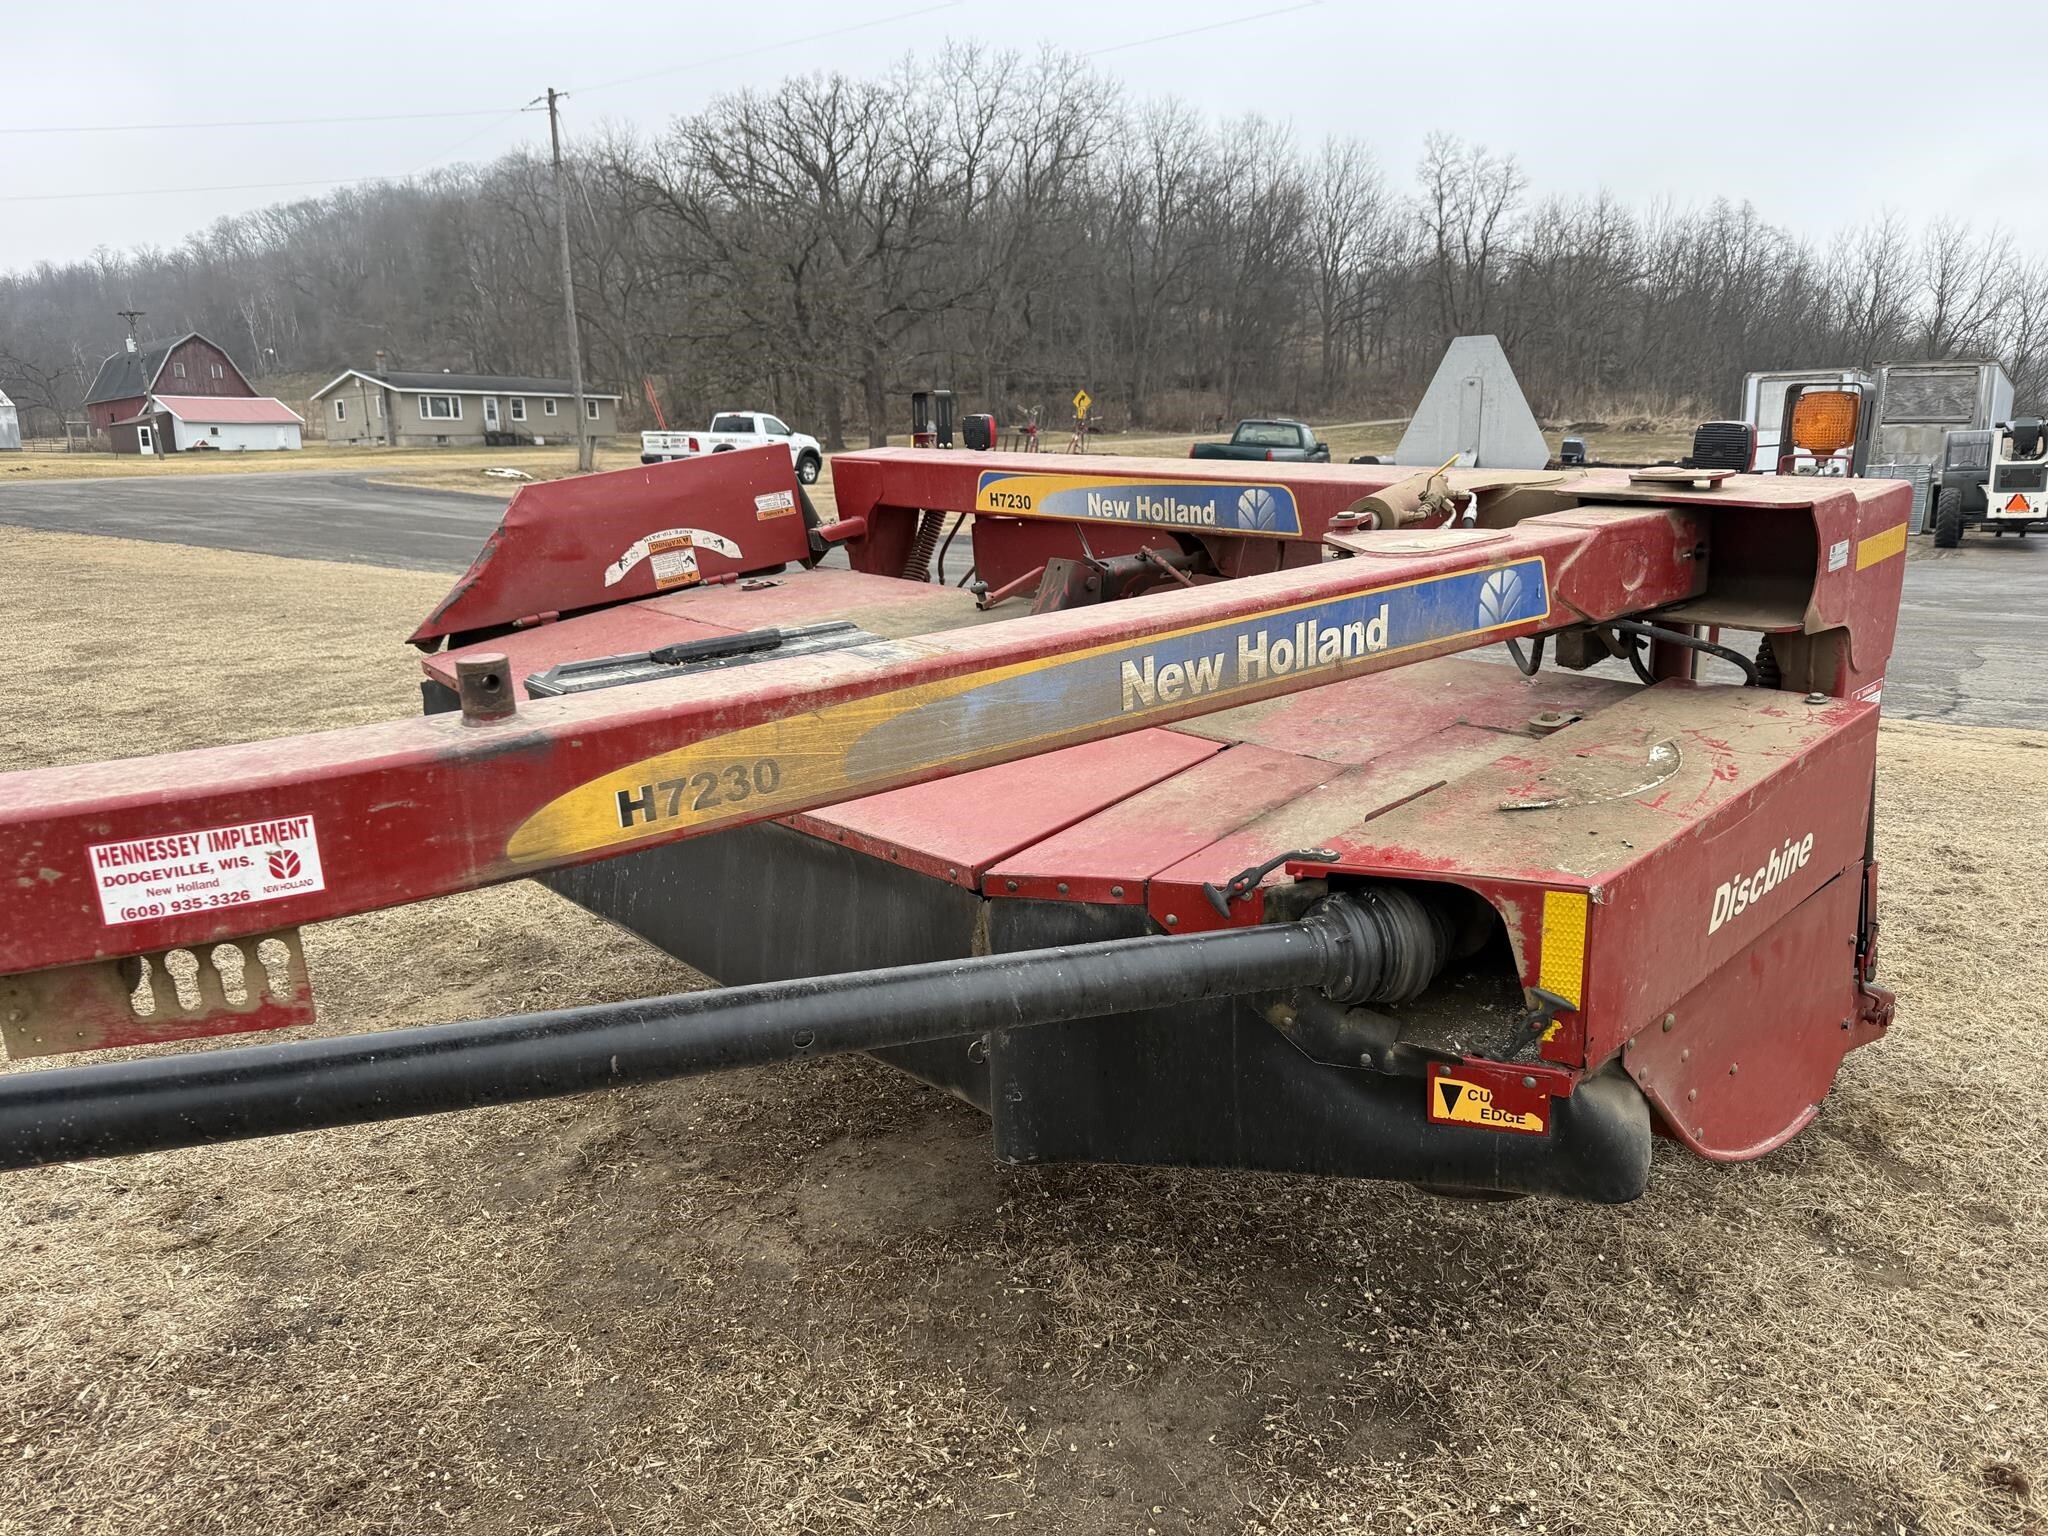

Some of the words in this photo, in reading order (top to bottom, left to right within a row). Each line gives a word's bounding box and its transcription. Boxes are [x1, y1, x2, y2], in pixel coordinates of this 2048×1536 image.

[990, 492, 1031, 510] H7230
[1087, 493, 1130, 519] New
[1136, 496, 1216, 525] Holland
[651, 537, 683, 549] WARNING
[1121, 654, 1224, 711] New
[1237, 604, 1390, 683] Holland
[615, 758, 781, 828] H7230
[96, 835, 200, 868] HENNESSEY
[207, 818, 310, 852] IMPLEMENT
[103, 862, 215, 888] DODGEVILLE,
[219, 855, 255, 871] WIS.
[263, 884, 280, 894] NEW
[280, 878, 314, 892] HOLLAND
[1708, 832, 1813, 936] Discbine
[146, 887, 172, 898] New
[177, 878, 221, 894] Holland
[121, 902, 165, 920] (608)
[171, 890, 251, 913] 935-3326
[1480, 1108, 1526, 1125] EDGE
